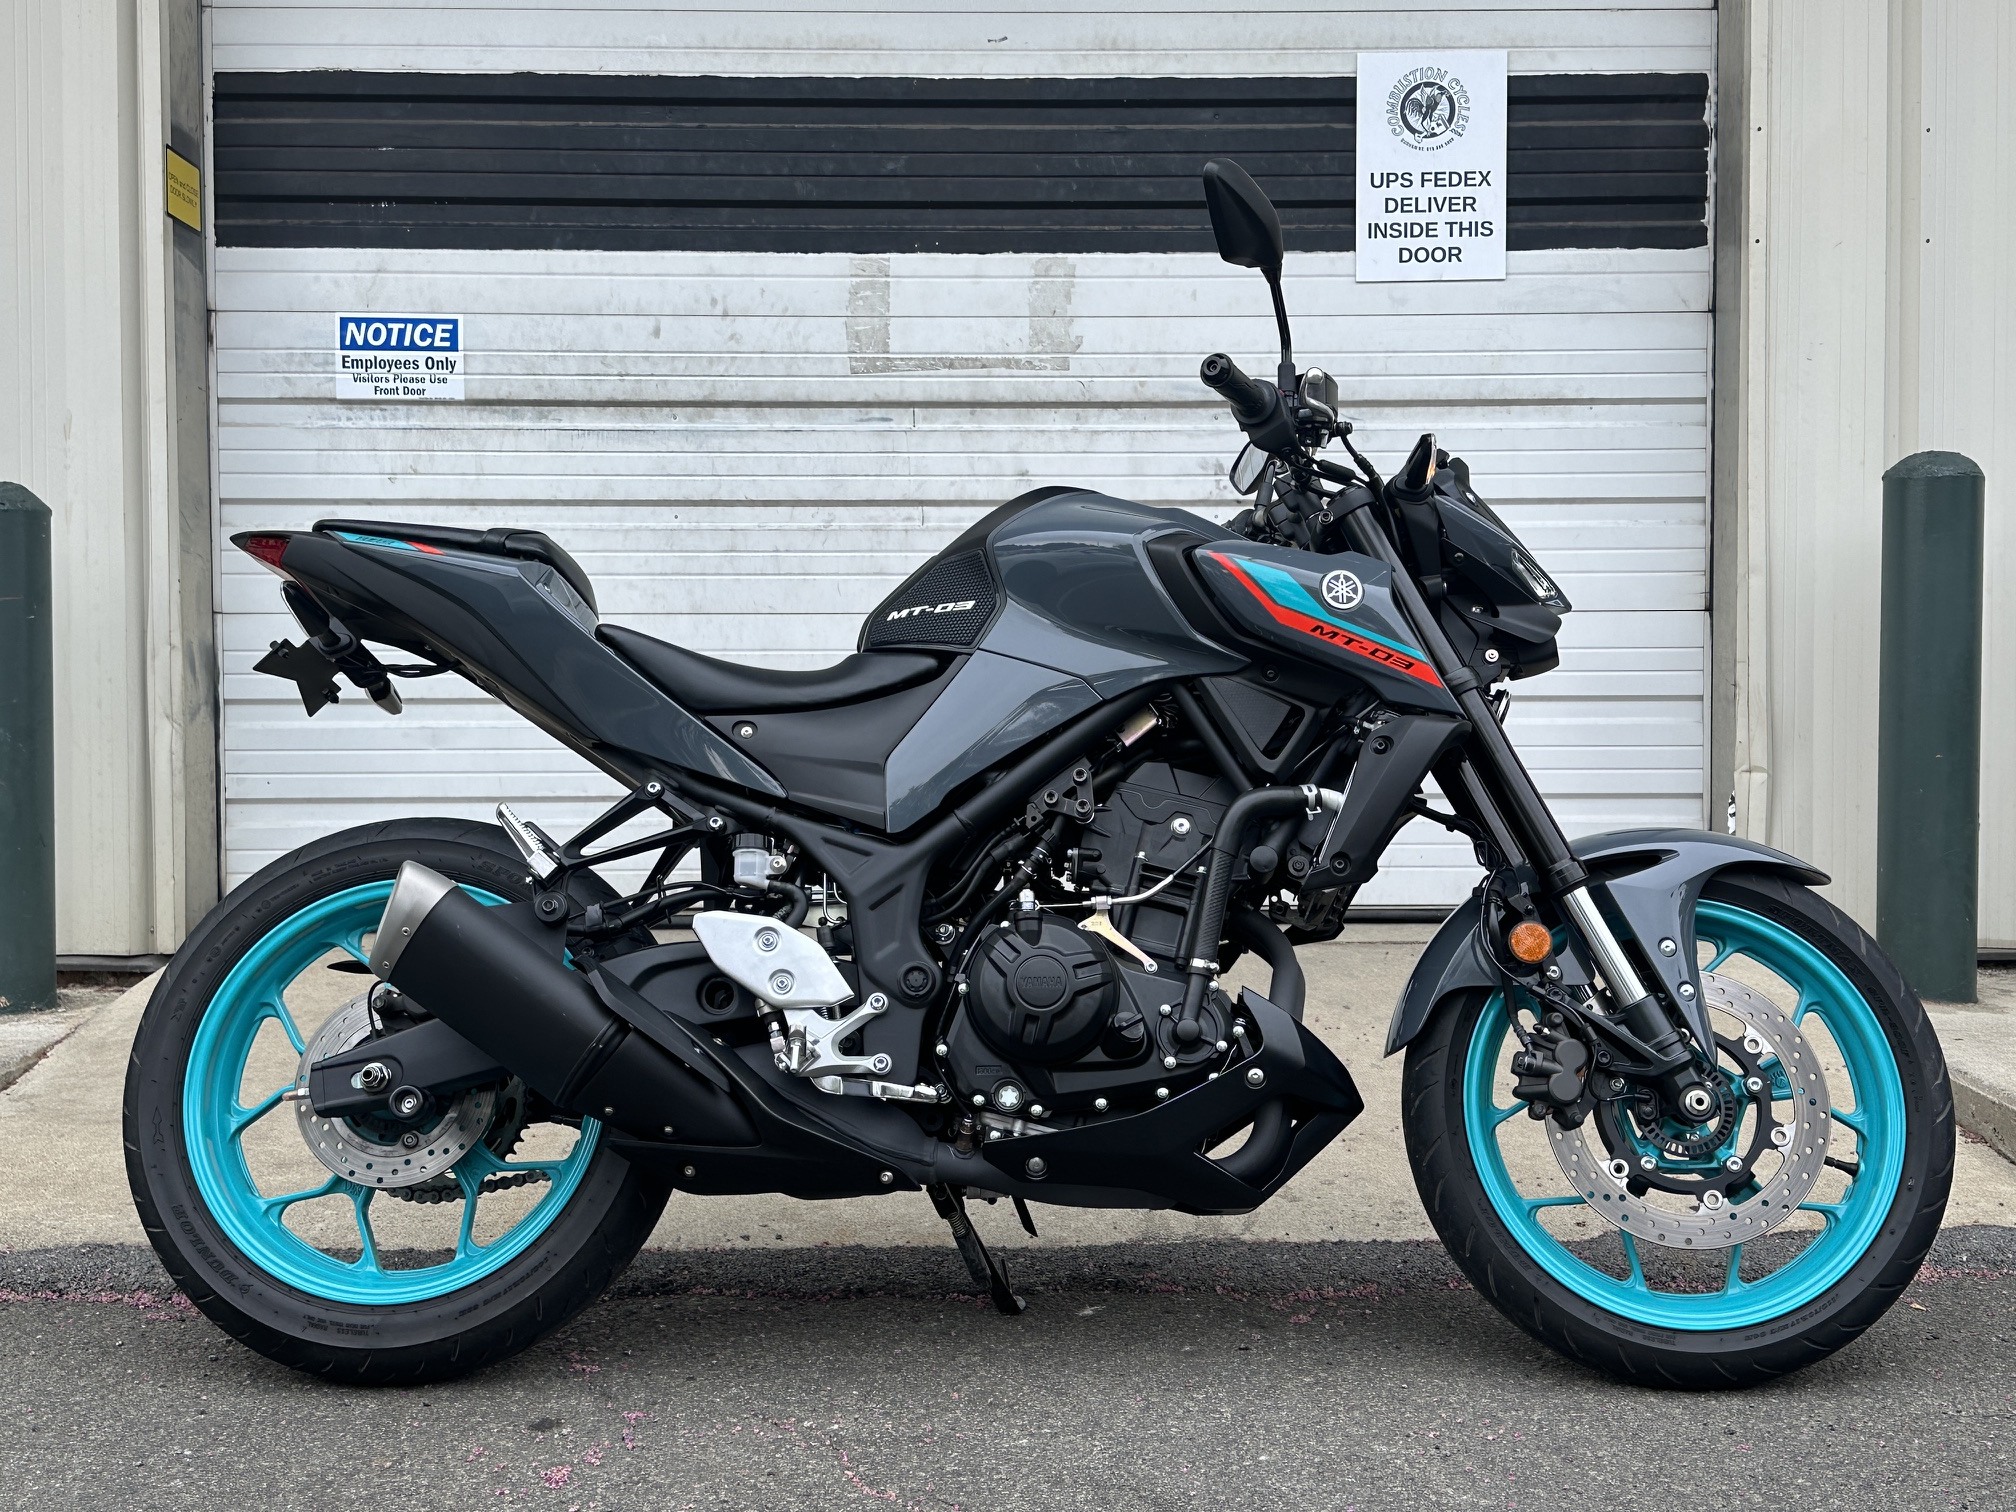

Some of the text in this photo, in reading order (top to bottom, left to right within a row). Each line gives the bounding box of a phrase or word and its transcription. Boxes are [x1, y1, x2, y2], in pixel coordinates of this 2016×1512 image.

[1386, 66, 1471, 136] COMBUSTION CYCLES
[1370, 170, 1492, 188] UPS FEDEX
[1384, 196, 1477, 213] DELIVER
[1368, 220, 1494, 239] INSIDE THIS
[1398, 246, 1463, 263] DOOR
[345, 322, 454, 347] NOTICE
[341, 354, 457, 374] Employees Only
[352, 373, 448, 384] Visitors Please Use
[374, 385, 427, 396] Front Door
[887, 600, 976, 621] MT-03
[1309, 624, 1415, 671] MT-03
[1020, 976, 1063, 989] YAMAHA
[171, 1204, 240, 1285] DUNLOP
